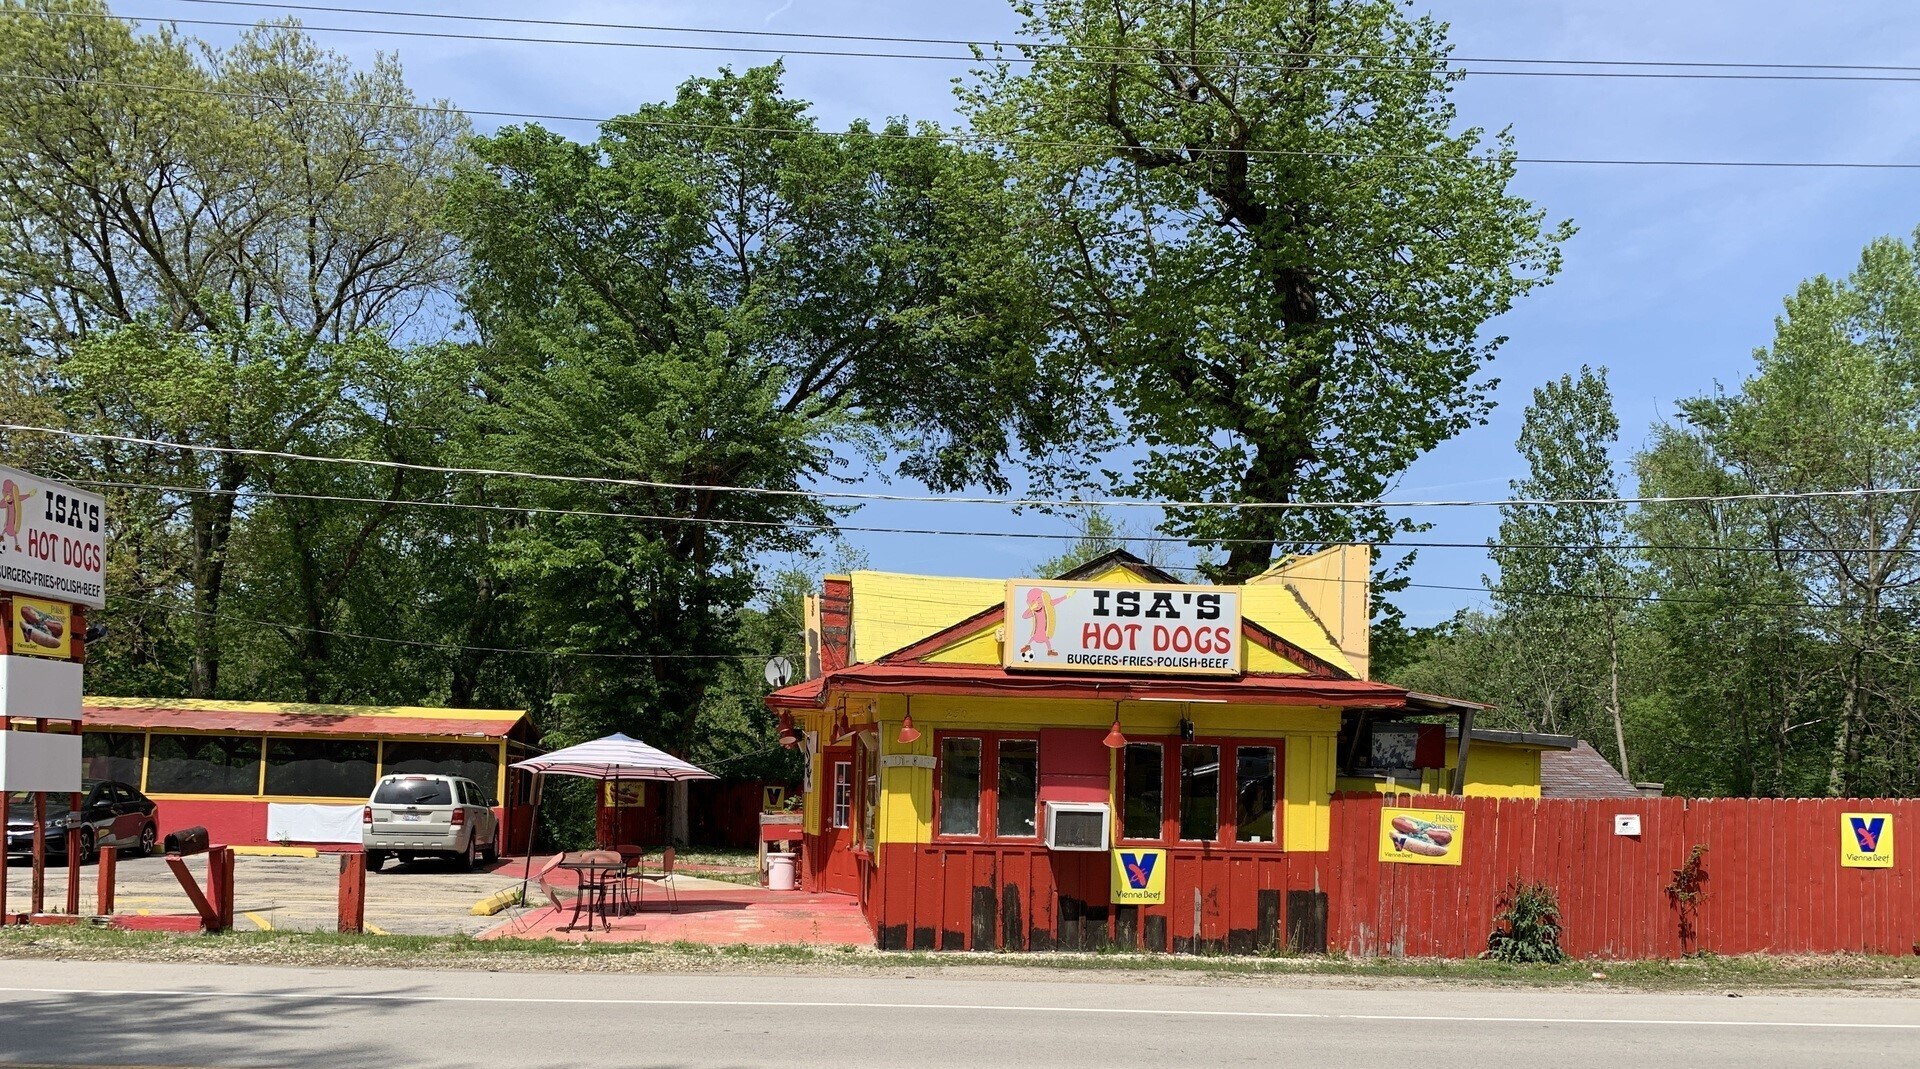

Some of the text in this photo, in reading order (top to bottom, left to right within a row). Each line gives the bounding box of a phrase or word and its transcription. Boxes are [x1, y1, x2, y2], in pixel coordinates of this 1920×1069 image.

[45, 490, 99, 533] ISA'S
[28, 528, 101, 573] HOT DOGS
[0, 564, 101, 598] URGERS FRIES POLISH BEEF
[1092, 589, 1221, 620] ISA'S
[1082, 622, 1232, 655] HOT DOGS
[1067, 653, 1229, 669] BURGERS FRIES POLISH BEEF
[1435, 814, 1455, 822] Polish
[1846, 853, 1889, 864] Vienna Beef
[1116, 890, 1161, 900] Vienna Beef
